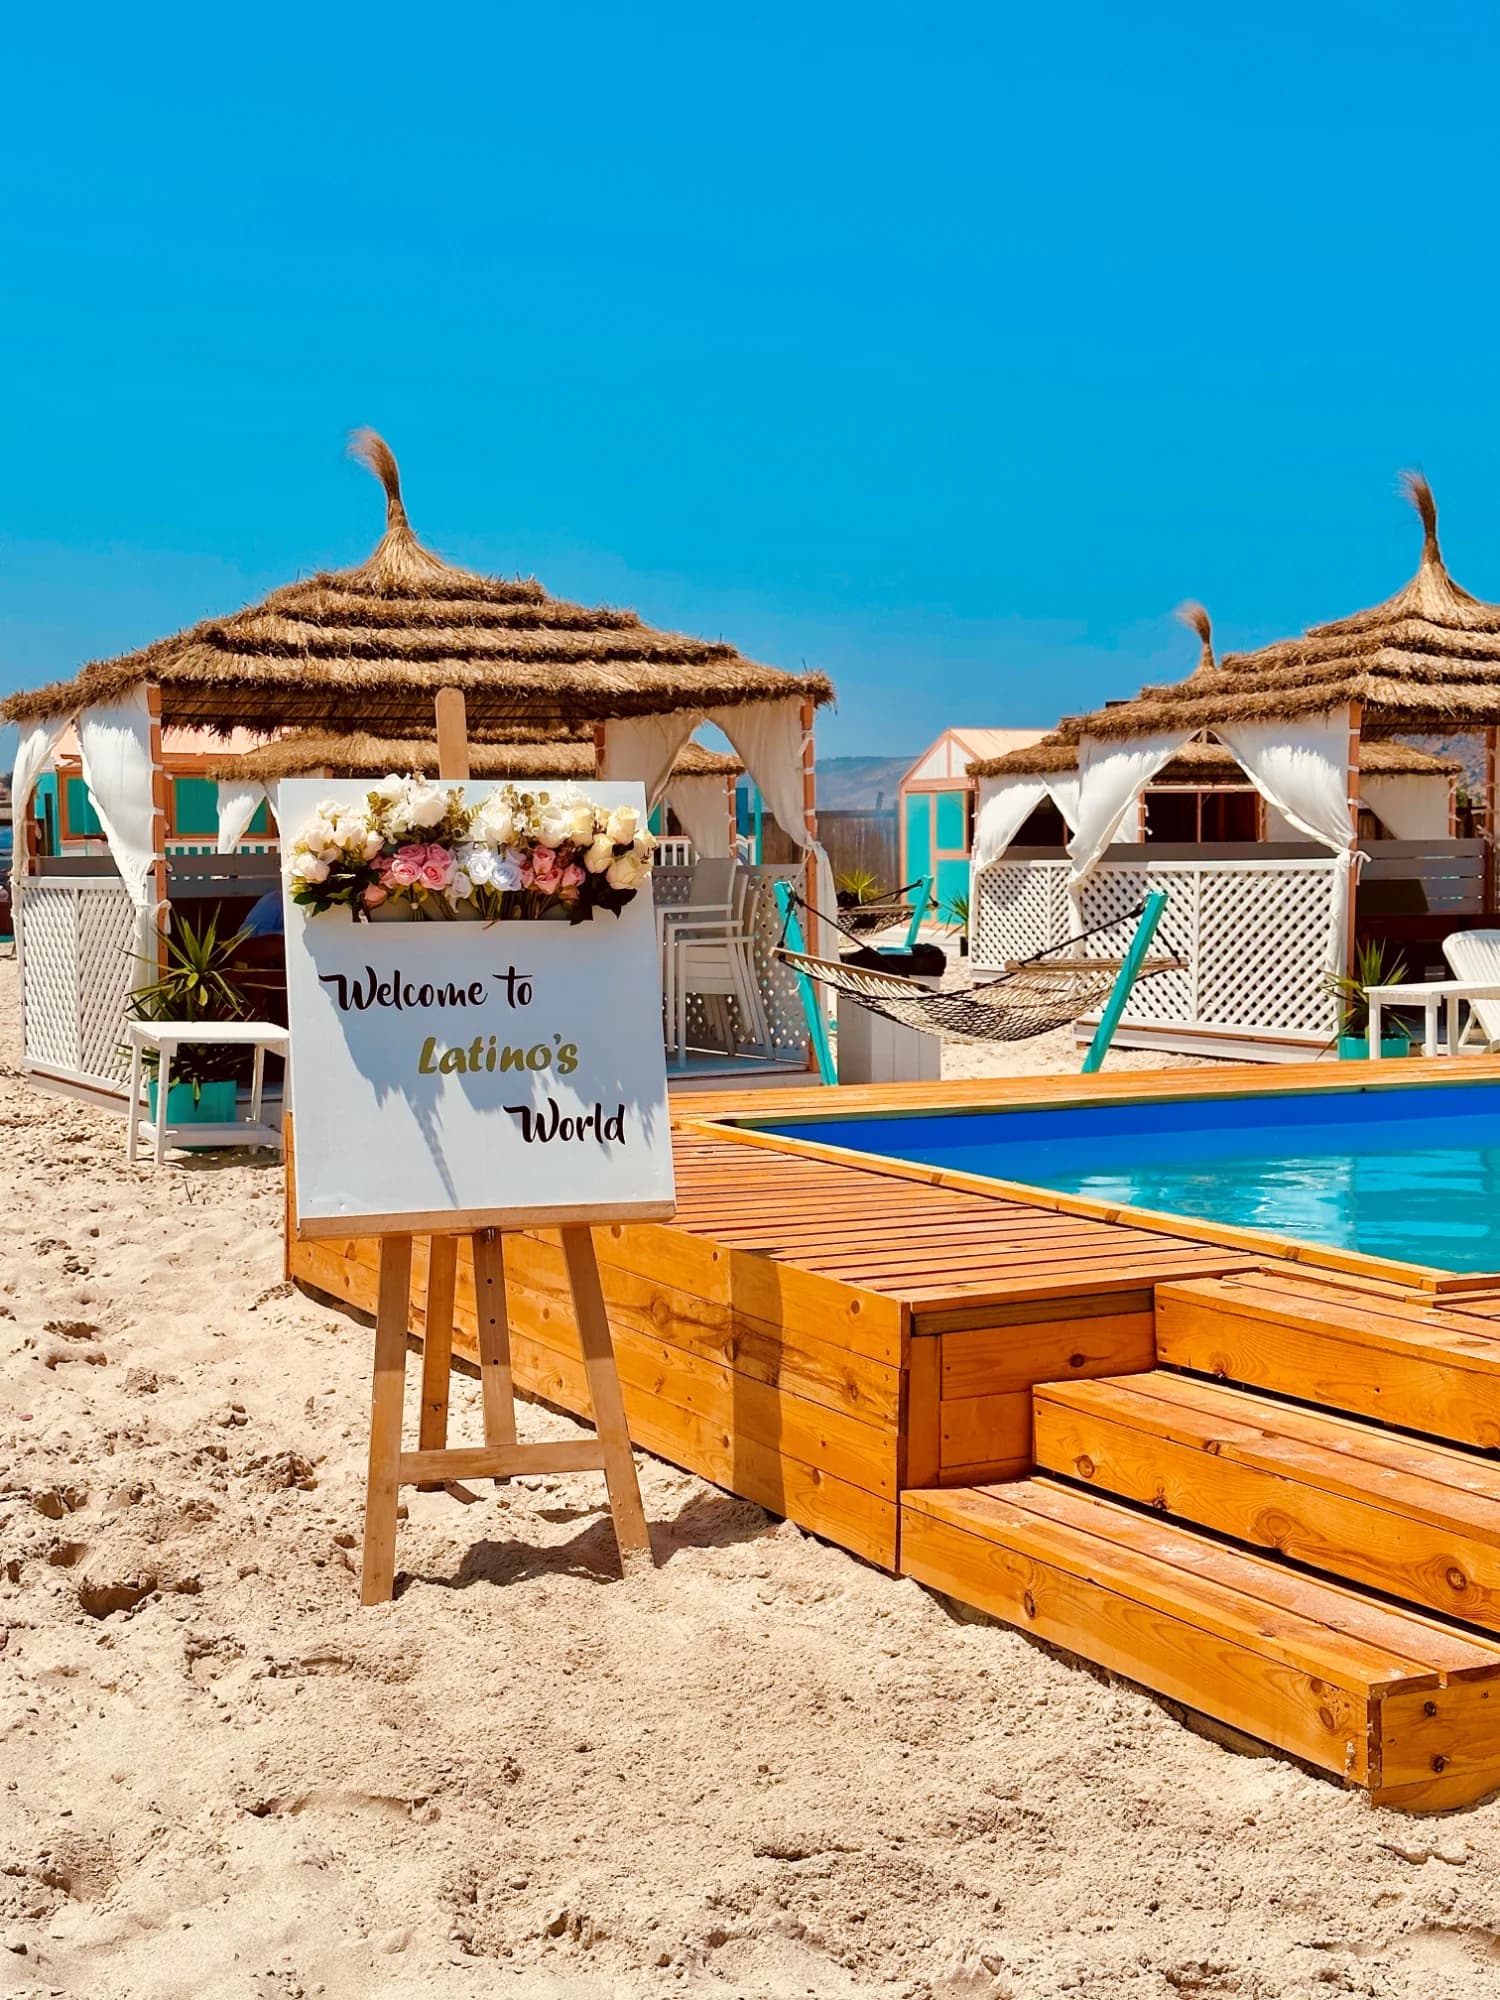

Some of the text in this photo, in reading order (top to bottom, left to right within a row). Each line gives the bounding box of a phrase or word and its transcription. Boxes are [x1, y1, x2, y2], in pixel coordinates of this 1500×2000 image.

[319, 966, 533, 1010] Welcome to
[418, 1034, 578, 1074] Latino's
[503, 1098, 626, 1144] World
